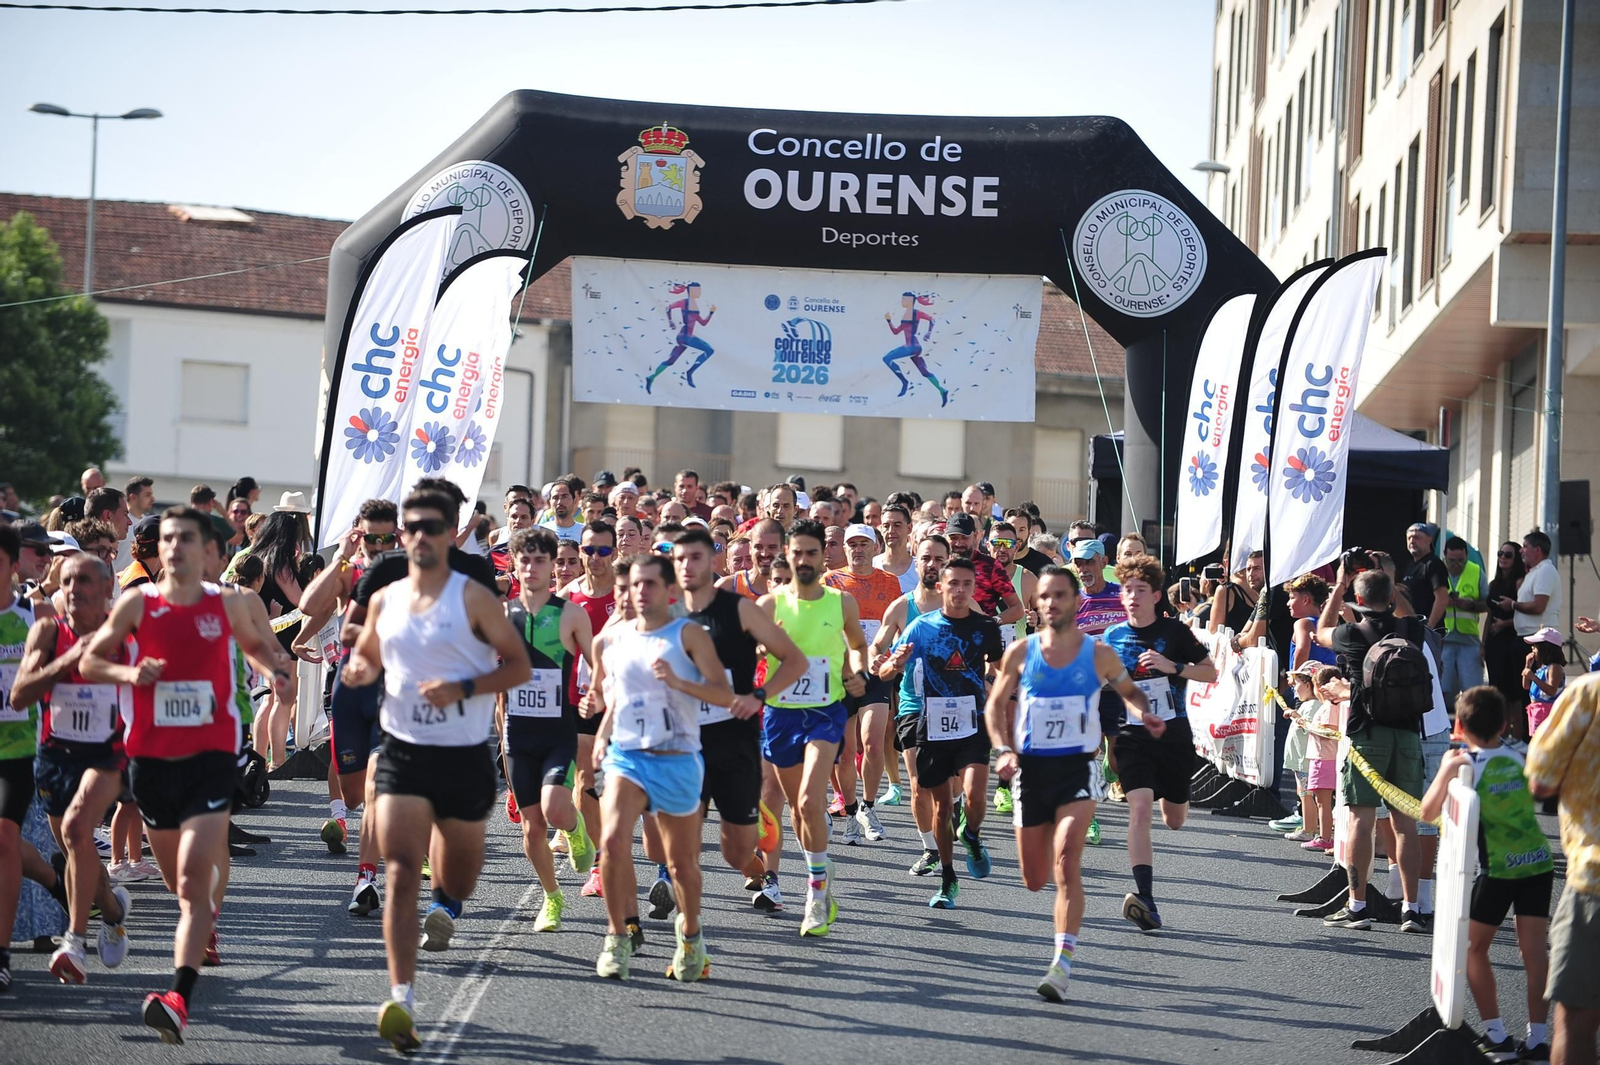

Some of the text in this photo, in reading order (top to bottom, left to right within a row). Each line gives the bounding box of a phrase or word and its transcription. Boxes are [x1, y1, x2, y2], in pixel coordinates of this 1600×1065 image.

[747, 128, 962, 162] Concello de
[430, 168, 525, 250] MUNICIPAL DE DEPORT
[743, 168, 1000, 217] OURENSE
[821, 226, 919, 248] Deportes
[1083, 197, 1197, 292] CONSELLO MUNICIPAL DE DEPORTES
[803, 304, 846, 313] OURENSE
[1114, 295, 1167, 311] OURENSE
[351, 322, 400, 399] chc
[394, 328, 420, 403] energía
[772, 364, 829, 386] 2026
[418, 343, 462, 414] chc
[452, 351, 481, 420] energía
[1193, 378, 1217, 442] chc
[1211, 384, 1229, 448] energía
[1288, 362, 1333, 439] chc
[1328, 366, 1351, 442] energía
[518, 689, 546, 709] 605
[792, 678, 811, 696] 22
[72, 710, 90, 732] 111
[164, 699, 201, 718] 1004
[941, 716, 960, 733] 94
[635, 718, 645, 737] 7
[1045, 720, 1066, 740] 27
